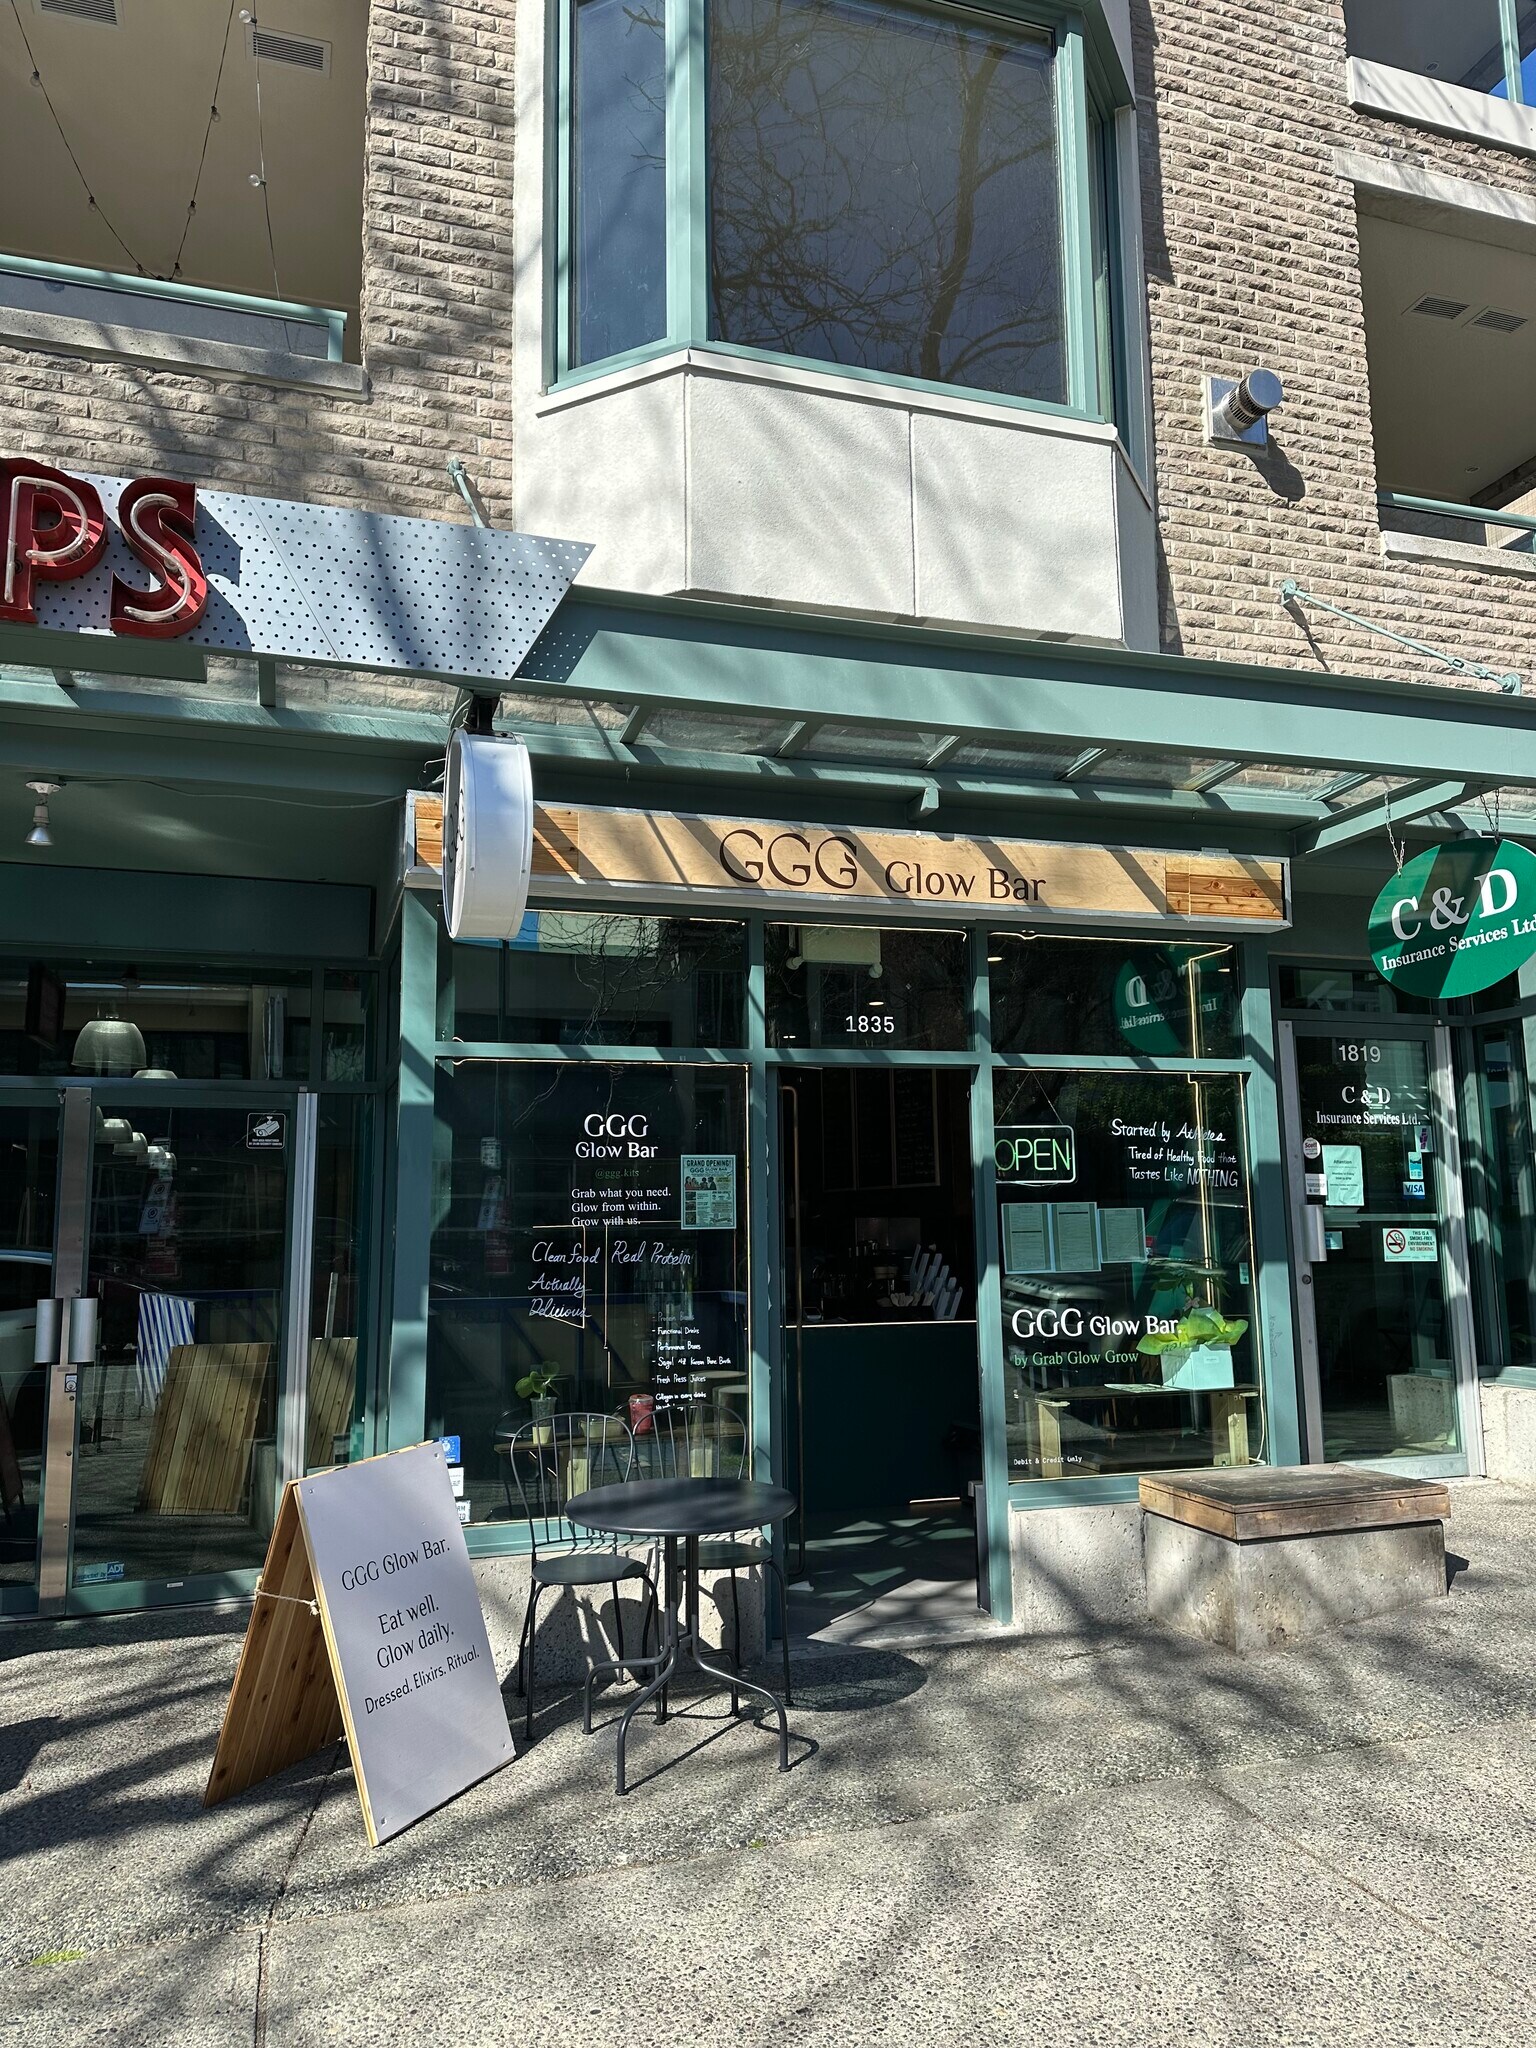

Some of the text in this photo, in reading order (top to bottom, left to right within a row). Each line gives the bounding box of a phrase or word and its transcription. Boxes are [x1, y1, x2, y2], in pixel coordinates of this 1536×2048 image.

[719, 829, 1046, 900] GGG Glow Bar
[1391, 868, 1518, 940] C & D
[1381, 944, 1446, 971] Insurance
[1450, 928, 1508, 952] Services
[845, 1015, 895, 1033] 1835
[1339, 1045, 1381, 1063] 1819
[1341, 1086, 1391, 1104] C & D
[584, 1114, 649, 1138] GGG
[1316, 1111, 1421, 1125] Insurance Services Ltd.
[1111, 1118, 1157, 1137] Started
[1162, 1121, 1171, 1143] by
[575, 1141, 659, 1158] Glow Bar
[994, 1138, 1071, 1171] OPEN
[1128, 1146, 1152, 1160] Tired
[1154, 1147, 1163, 1159] of
[1166, 1148, 1194, 1166] Healthy
[1218, 1151, 1237, 1163] that
[595, 1168, 640, 1179] @ggg.kits
[1129, 1167, 1238, 1187] Tastes Like NOTHING
[571, 1187, 671, 1200] Grab what you need.
[1405, 1184, 1424, 1193] VISA
[571, 1201, 661, 1213] Glow from within.
[571, 1216, 641, 1227] Grow with us.
[531, 1241, 566, 1263] Clean
[611, 1240, 646, 1264] Real
[650, 1241, 693, 1265] Protein
[528, 1273, 592, 1299] Actually
[529, 1298, 592, 1318] Delicious
[1011, 1308, 1182, 1338] GGG Glow Bar.
[1014, 1349, 1139, 1369] by Grab Glow Grow
[656, 1375, 670, 1384] Fresh
[674, 1373, 687, 1383] Press
[1013, 1458, 1032, 1466] Debit
[1042, 1456, 1064, 1464] Credit
[108, 1564, 124, 1574] ADT
[341, 1538, 450, 1591] GGG Glow Bar.
[378, 1594, 439, 1634] Eat well.
[376, 1622, 455, 1669] Glow daily.
[364, 1645, 480, 1714] Dressed. Elixirs. Ritual.
